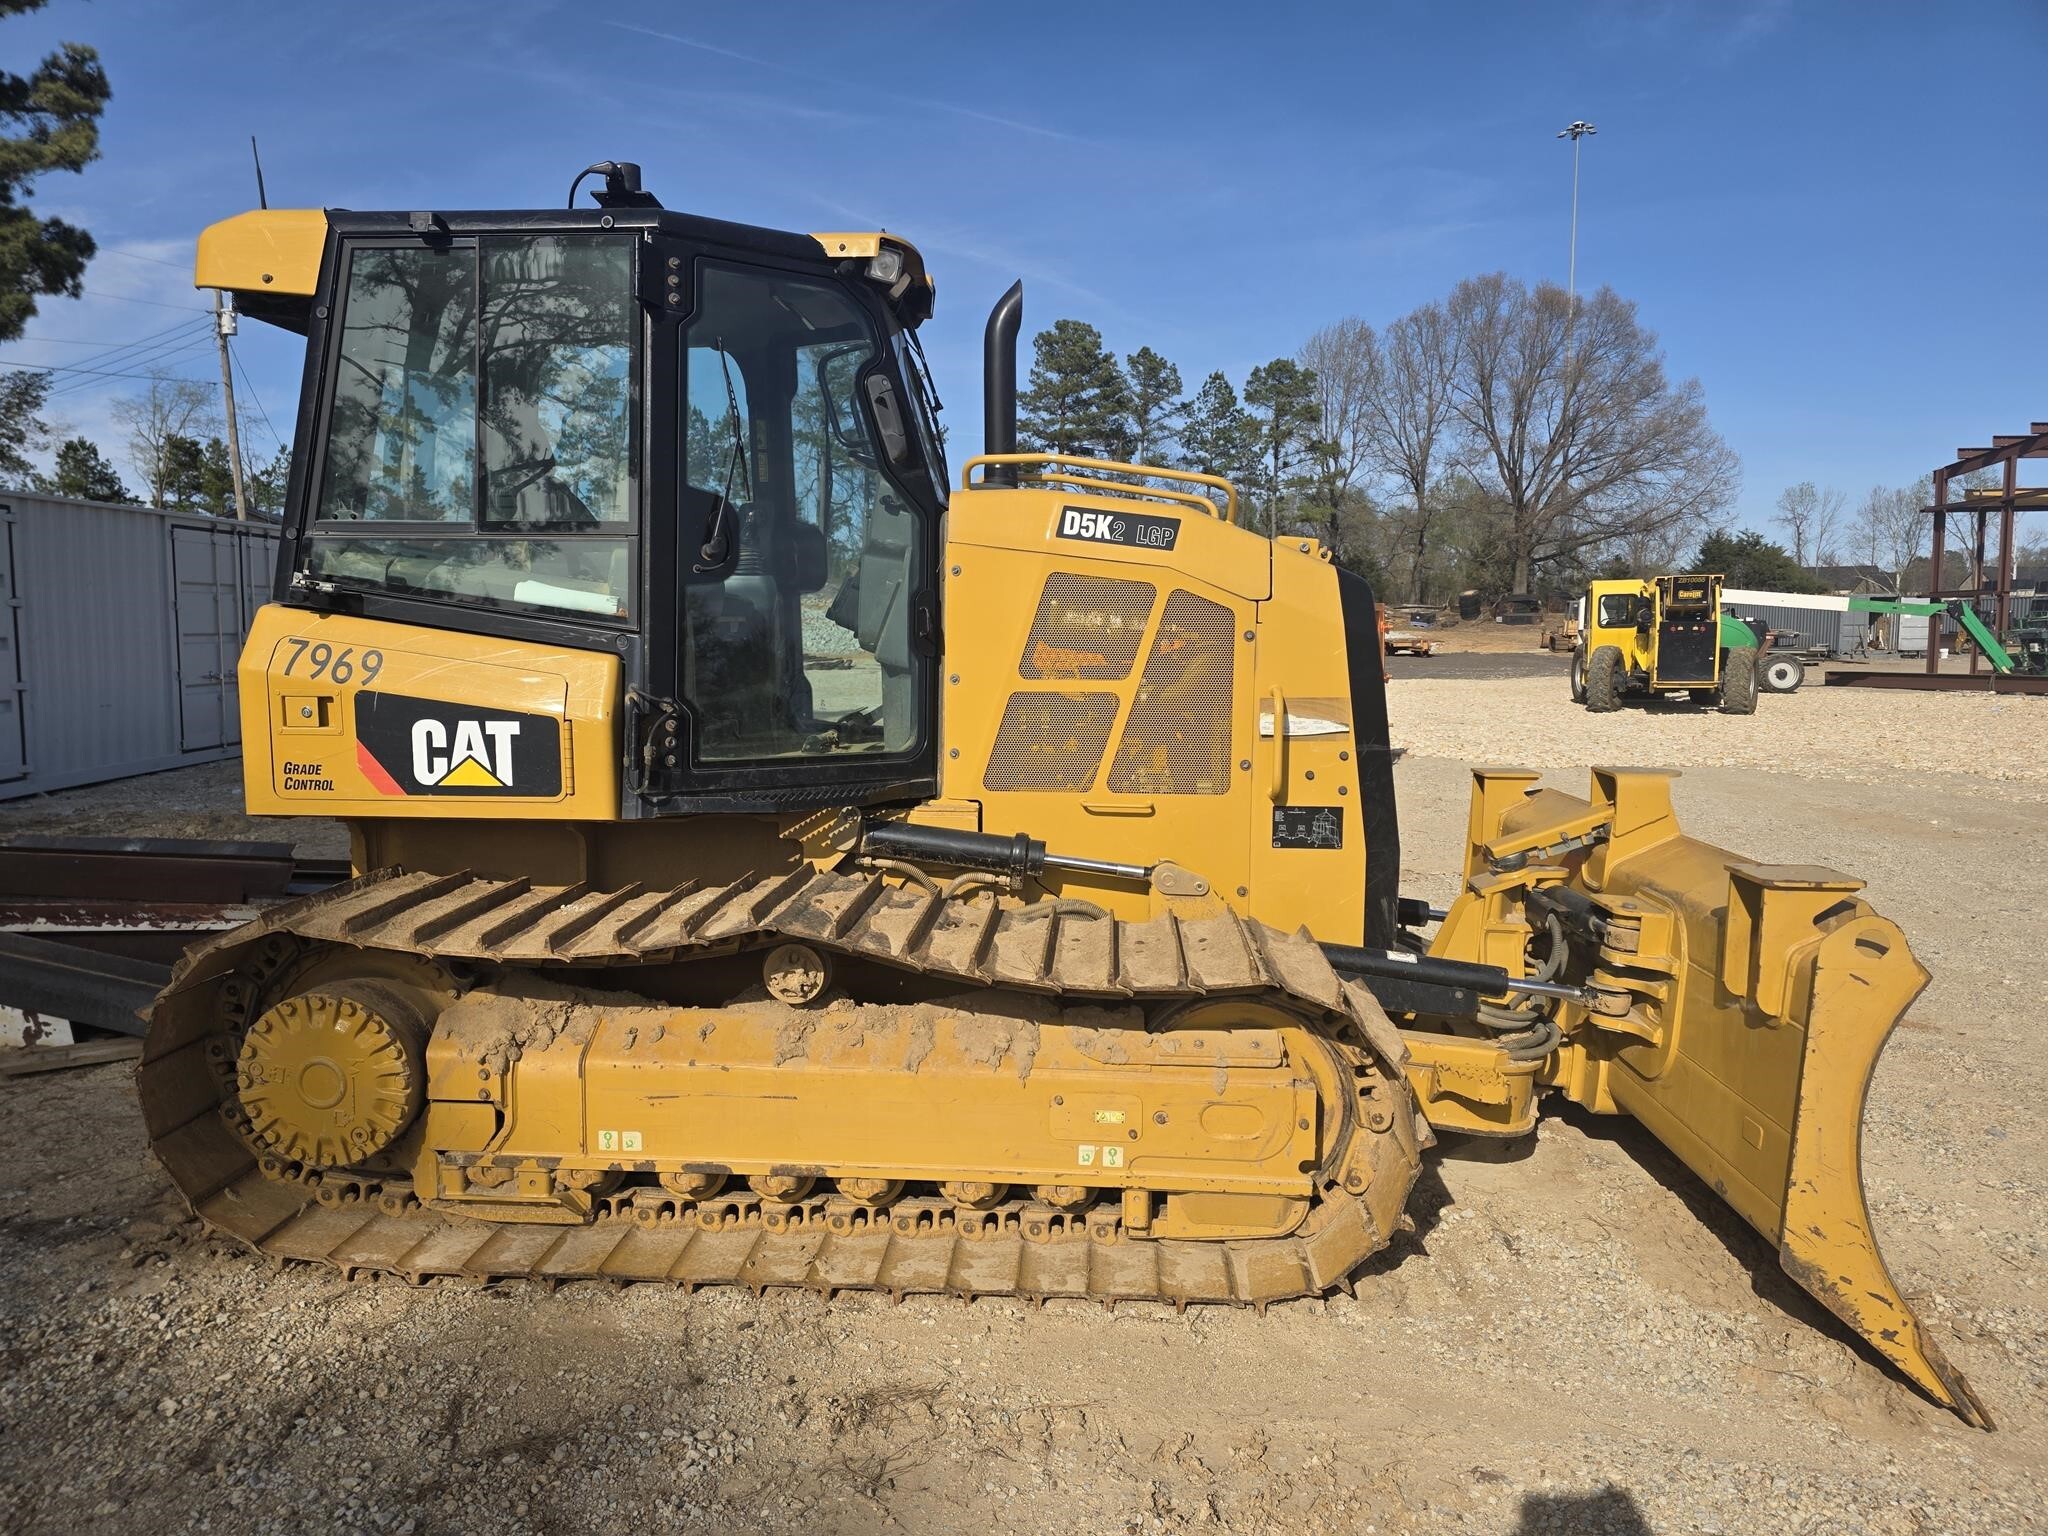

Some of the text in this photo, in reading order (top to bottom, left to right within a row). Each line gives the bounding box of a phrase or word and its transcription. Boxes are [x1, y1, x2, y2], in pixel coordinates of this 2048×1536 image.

[1063, 510, 1174, 546] D5K2 LGP
[284, 638, 383, 686] 7969
[412, 719, 520, 787] CAT
